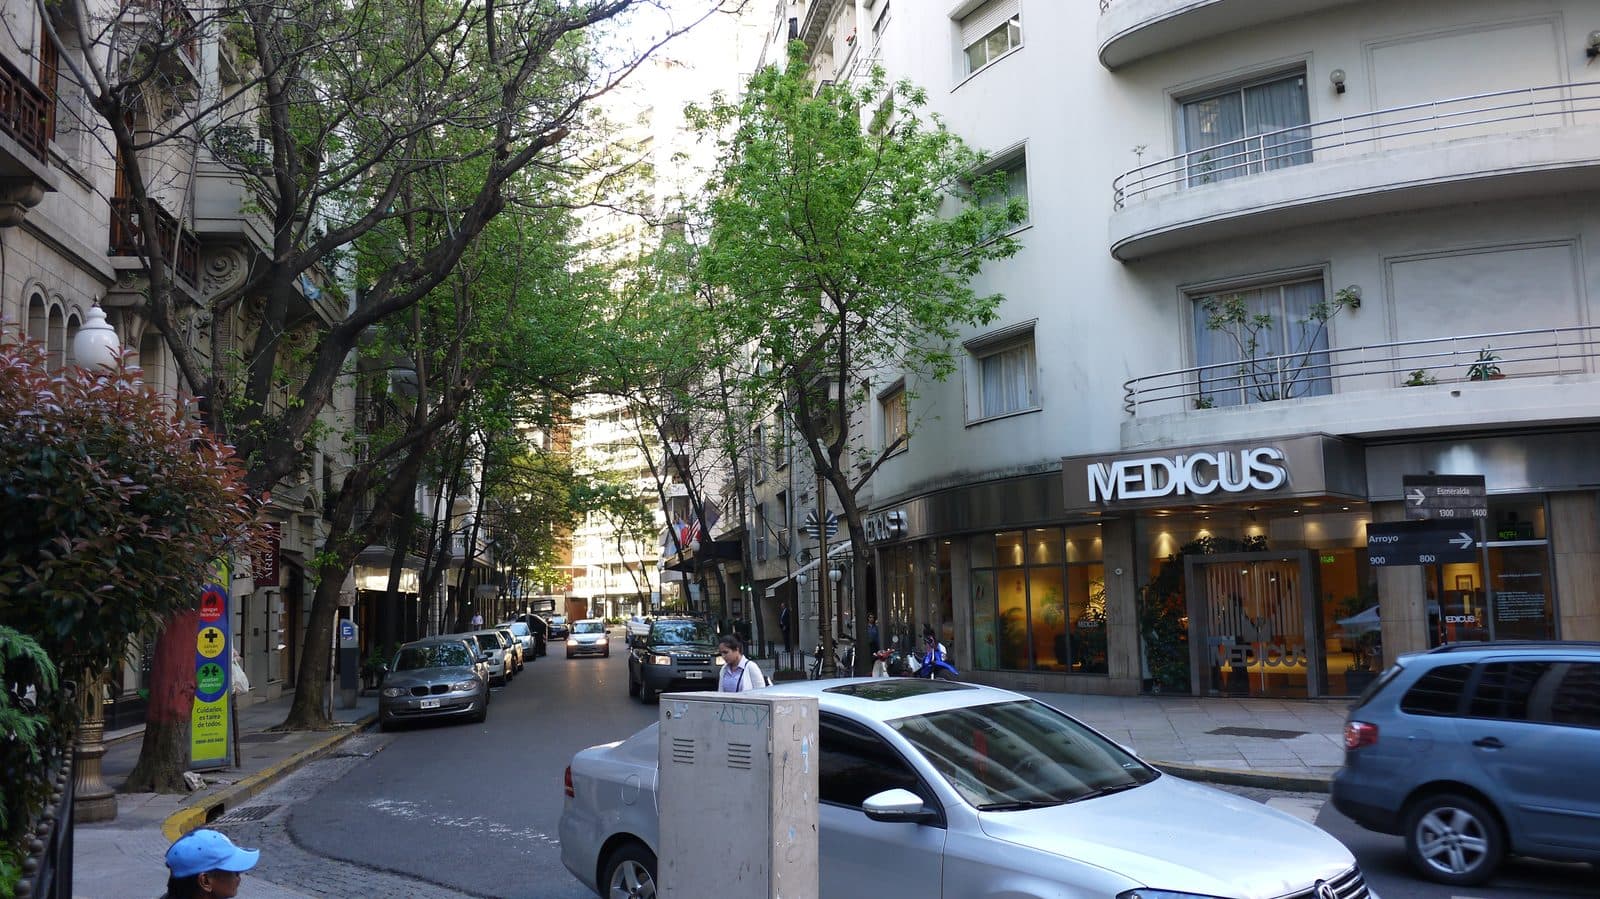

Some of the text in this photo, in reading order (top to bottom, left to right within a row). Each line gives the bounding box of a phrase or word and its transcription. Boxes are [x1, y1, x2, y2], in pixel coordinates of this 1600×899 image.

[1087, 447, 1287, 502] MEDICUS
[1436, 487, 1470, 496] Esmeralda
[1439, 508, 1487, 518] 1300 1400
[864, 510, 908, 541] EDICUS
[1368, 534, 1399, 544] Arroyo
[1369, 554, 1436, 565] 900 800
[1445, 615, 1476, 623] EDICUS
[343, 626, 352, 635] E
